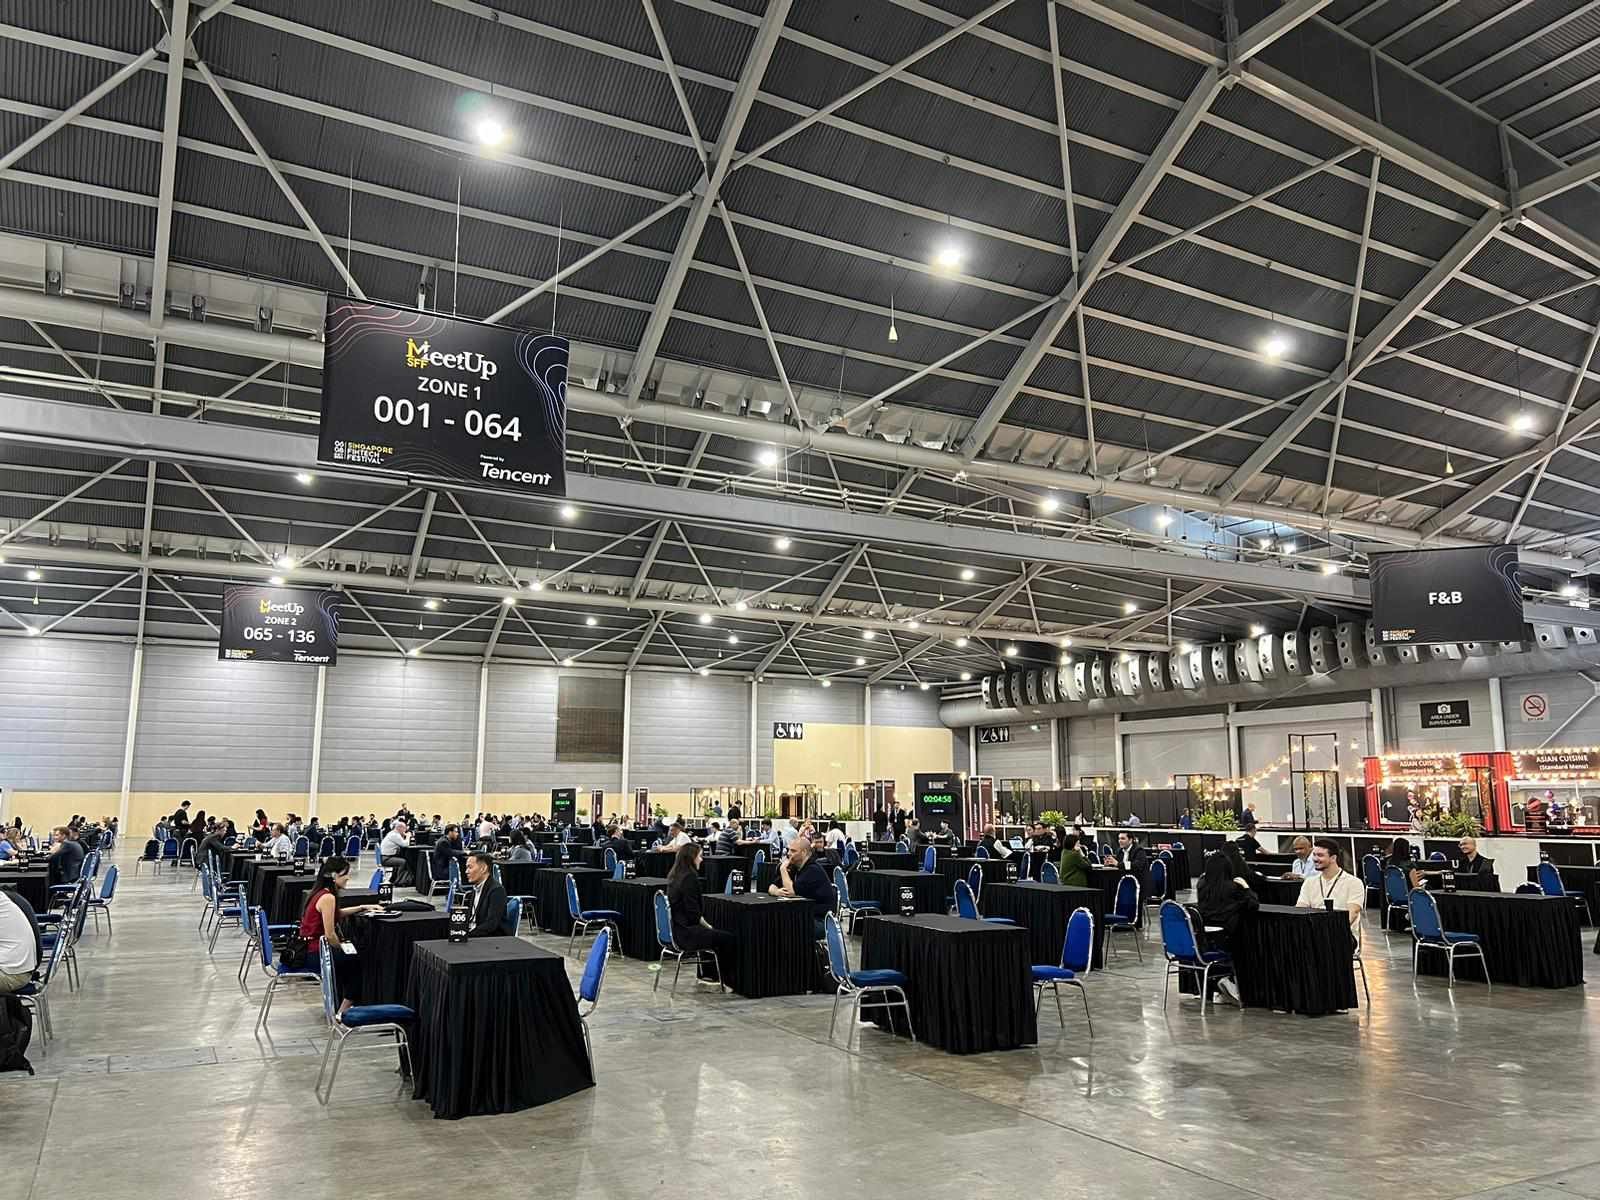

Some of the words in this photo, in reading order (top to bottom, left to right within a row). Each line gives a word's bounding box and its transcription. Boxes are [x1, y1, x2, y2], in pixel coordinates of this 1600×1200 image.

[406, 338, 497, 380] MeetUp
[407, 358, 429, 368] SFF
[417, 376, 468, 398] ZONE
[473, 386, 481, 400] 1
[374, 395, 430, 428] 001
[464, 409, 522, 442] 064
[480, 462, 552, 485] Tencent
[1428, 591, 1463, 605] F&B
[260, 600, 304, 615] MeetUp
[265, 616, 289, 625] ZONE
[291, 618, 297, 626] 2
[244, 627, 273, 641] 065
[287, 629, 316, 643] 136
[294, 653, 330, 663] Tencent
[1536, 755, 1558, 763] ASIAN
[1559, 754, 1589, 762] CUISINE
[451, 913, 466, 922] 006
